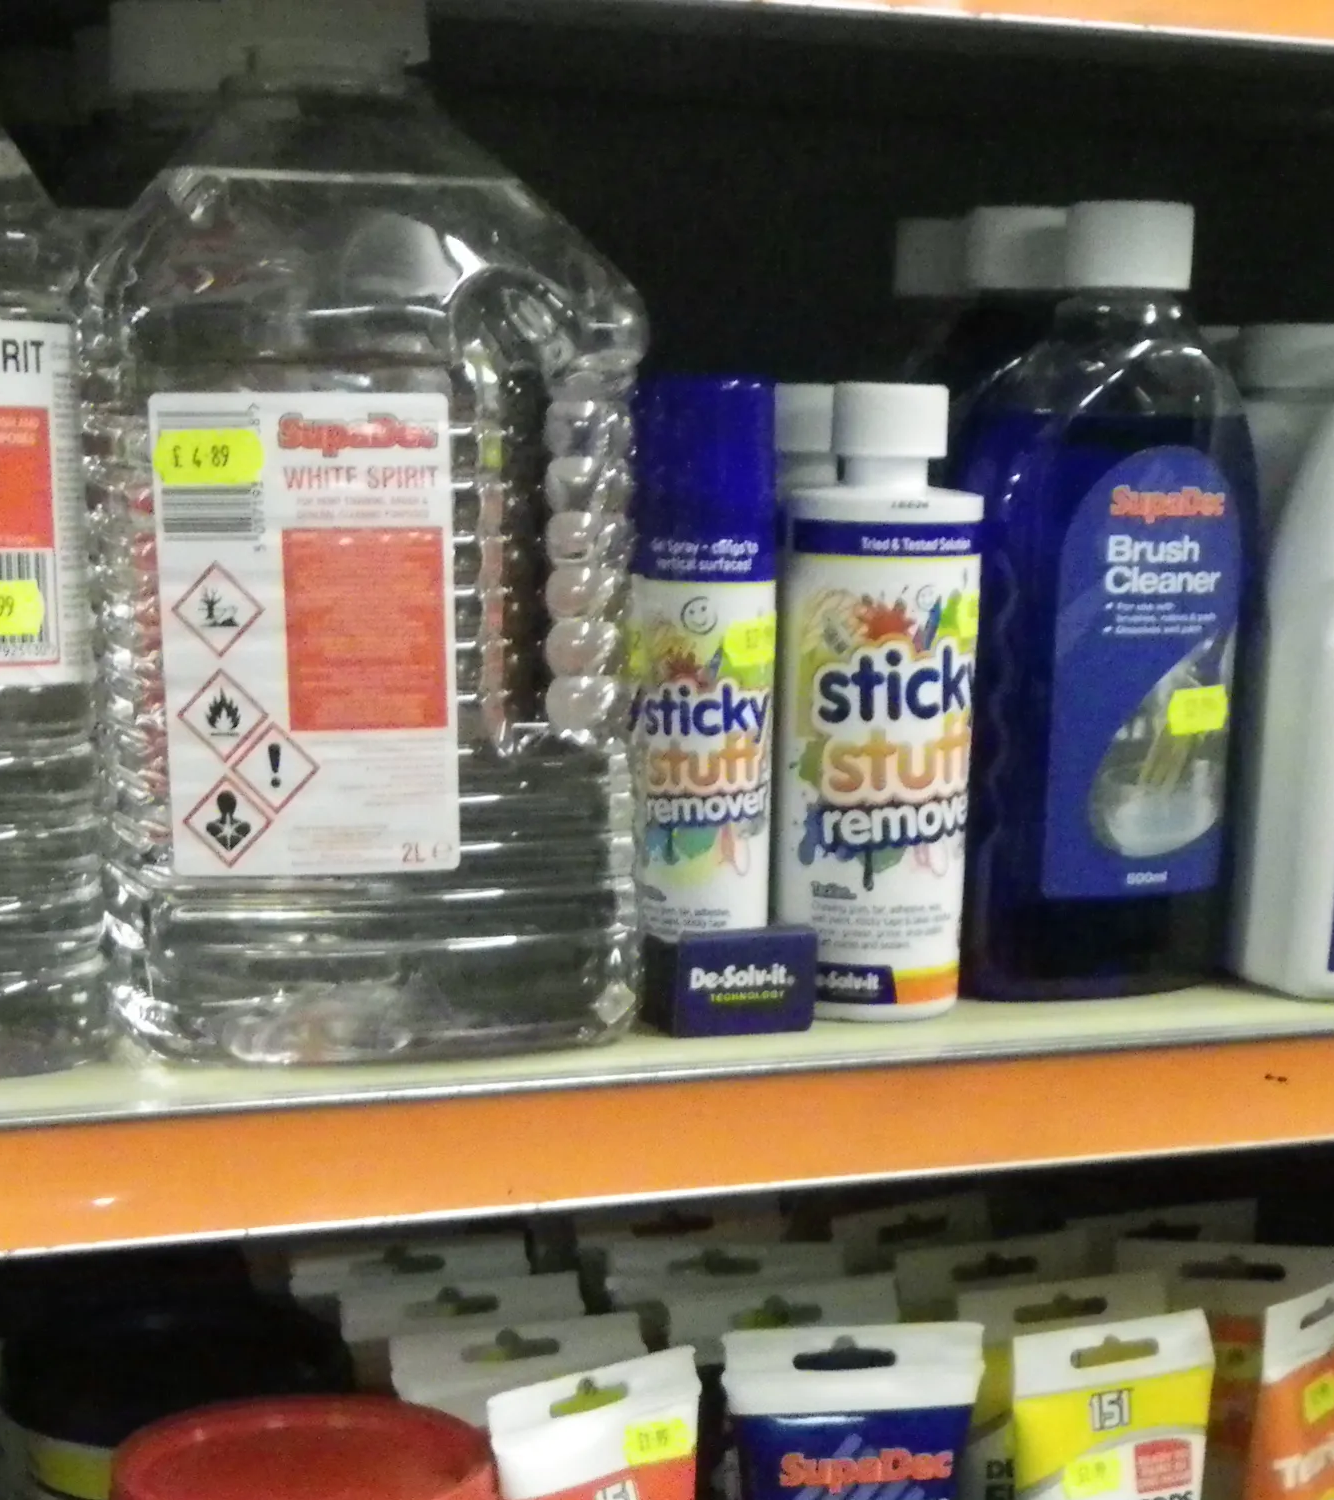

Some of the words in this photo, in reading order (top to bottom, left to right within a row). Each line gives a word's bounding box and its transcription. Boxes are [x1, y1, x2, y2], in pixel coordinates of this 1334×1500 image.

[283, 465, 358, 491] WHITE
[367, 465, 439, 489] SPIRIT
[1106, 534, 1201, 563] Brush
[1104, 565, 1222, 595] Cleaner
[644, 680, 770, 746] sticky
[822, 794, 968, 845] remove
[401, 843, 428, 863] 2L
[1089, 1389, 1132, 1432] 151
[779, 1447, 954, 1496] SupaDec
